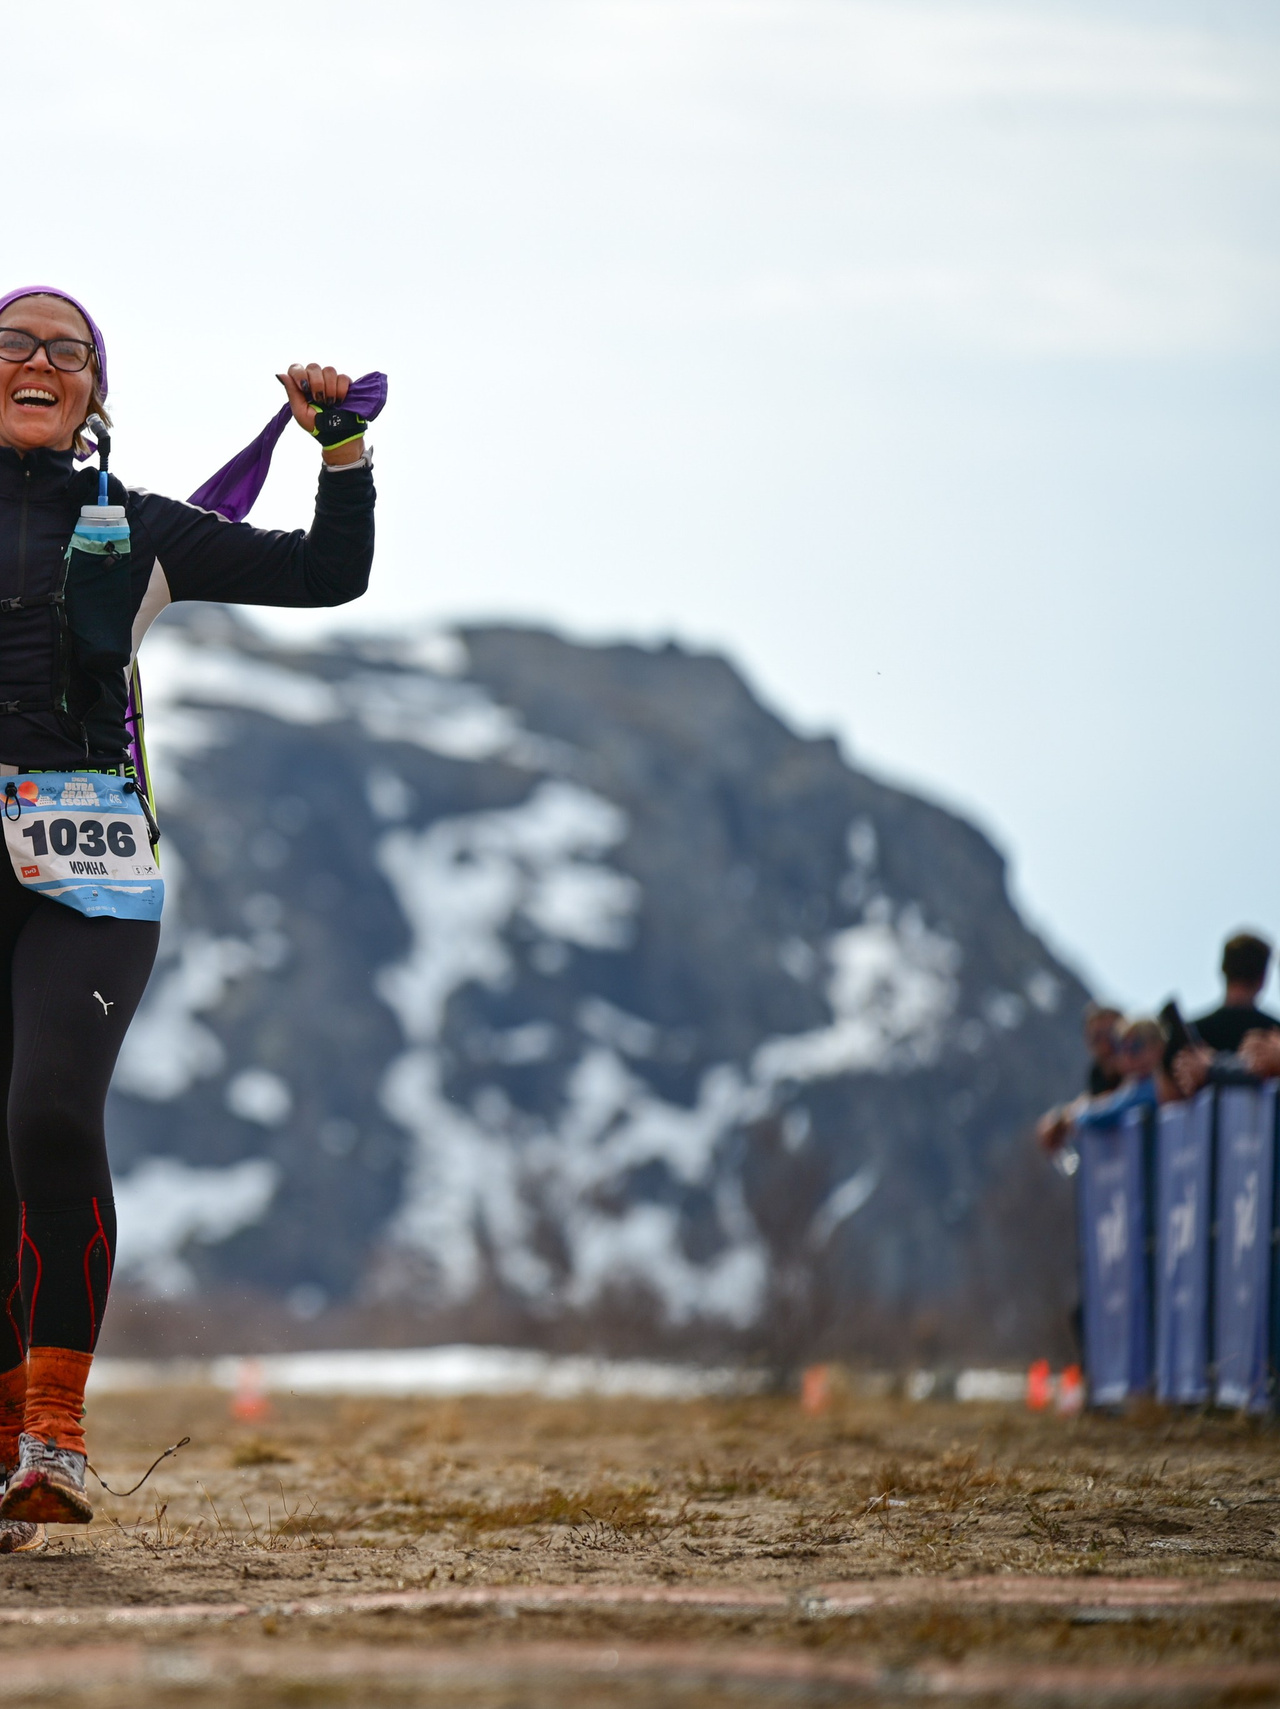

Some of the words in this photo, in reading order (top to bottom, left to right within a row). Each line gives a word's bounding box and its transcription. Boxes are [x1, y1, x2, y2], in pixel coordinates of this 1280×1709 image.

[64, 782, 95, 792] ULTRA
[61, 790, 98, 799] GRAND
[59, 798, 101, 807] ESCAPE
[21, 818, 137, 858] 1036
[68, 860, 109, 876] ИРИНА
